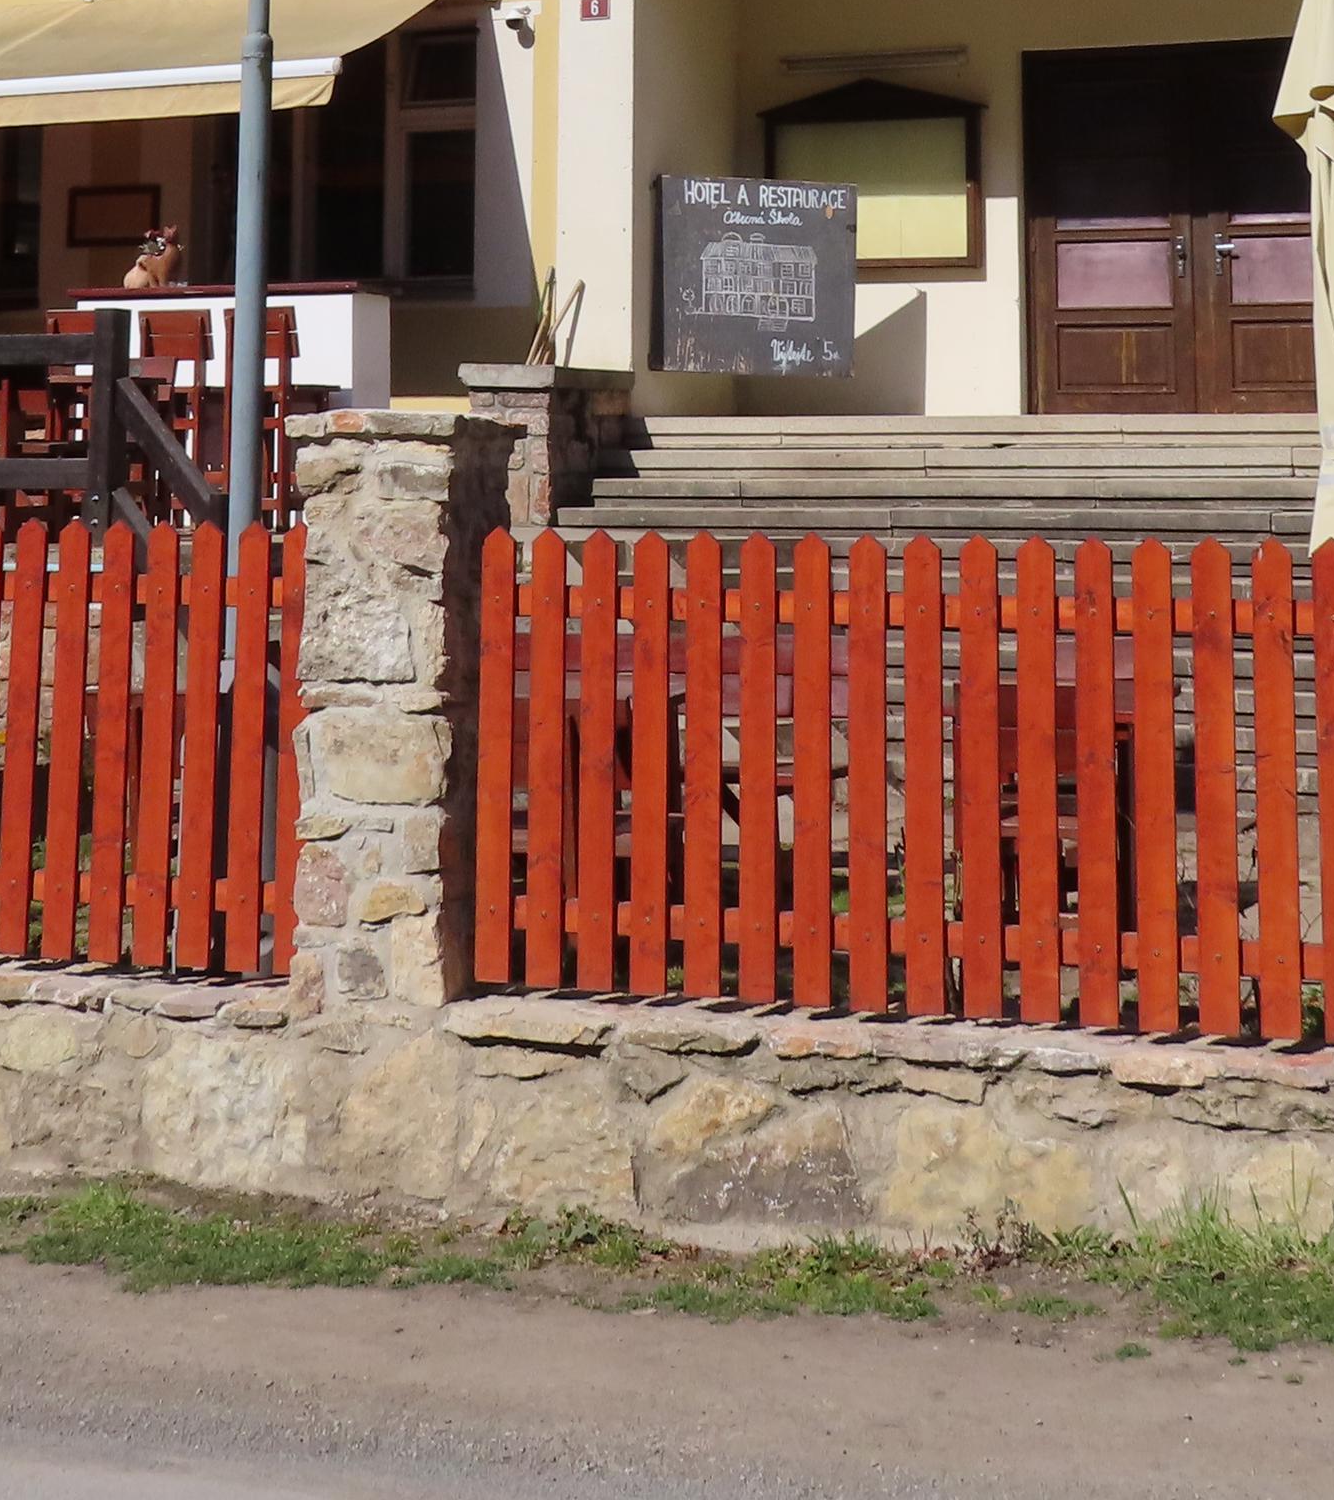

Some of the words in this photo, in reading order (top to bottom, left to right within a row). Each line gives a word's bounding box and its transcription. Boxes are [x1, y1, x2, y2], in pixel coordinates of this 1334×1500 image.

[590, 0, 600, 16] 6
[684, 179, 731, 205] HOTEL
[737, 184, 750, 206] A
[759, 185, 847, 210] RESTAURACE
